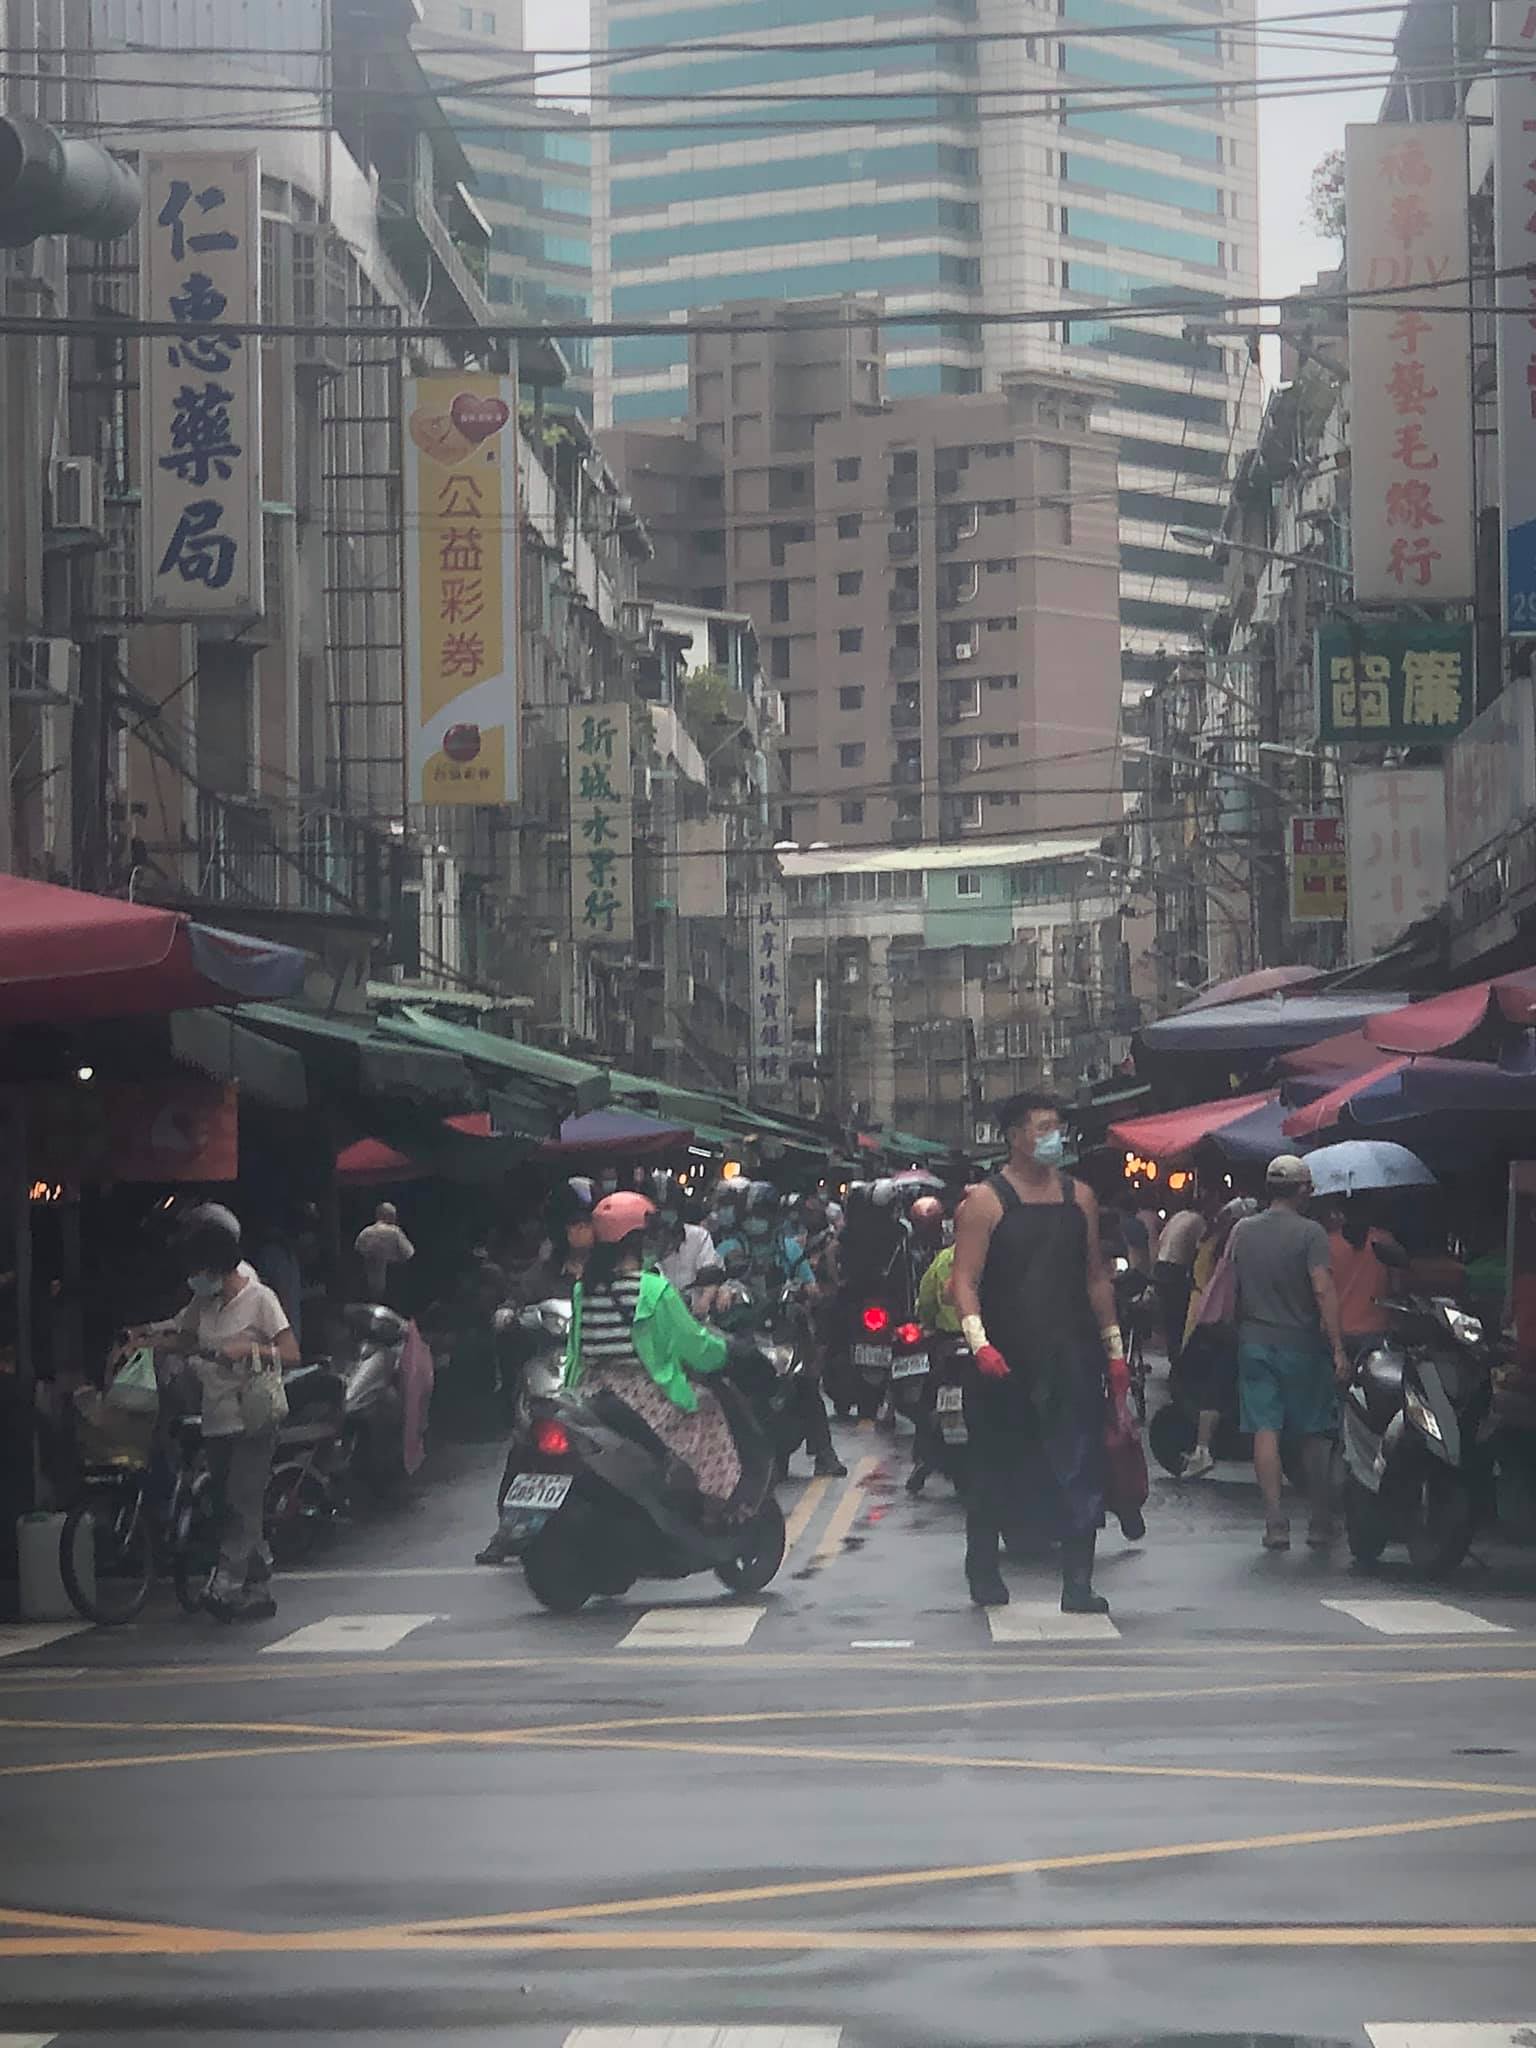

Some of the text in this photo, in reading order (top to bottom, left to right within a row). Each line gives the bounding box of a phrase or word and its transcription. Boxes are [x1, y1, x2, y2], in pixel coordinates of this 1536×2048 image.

[158, 181, 241, 589] 仁惠藥局
[438, 475, 484, 678] 公益彩券
